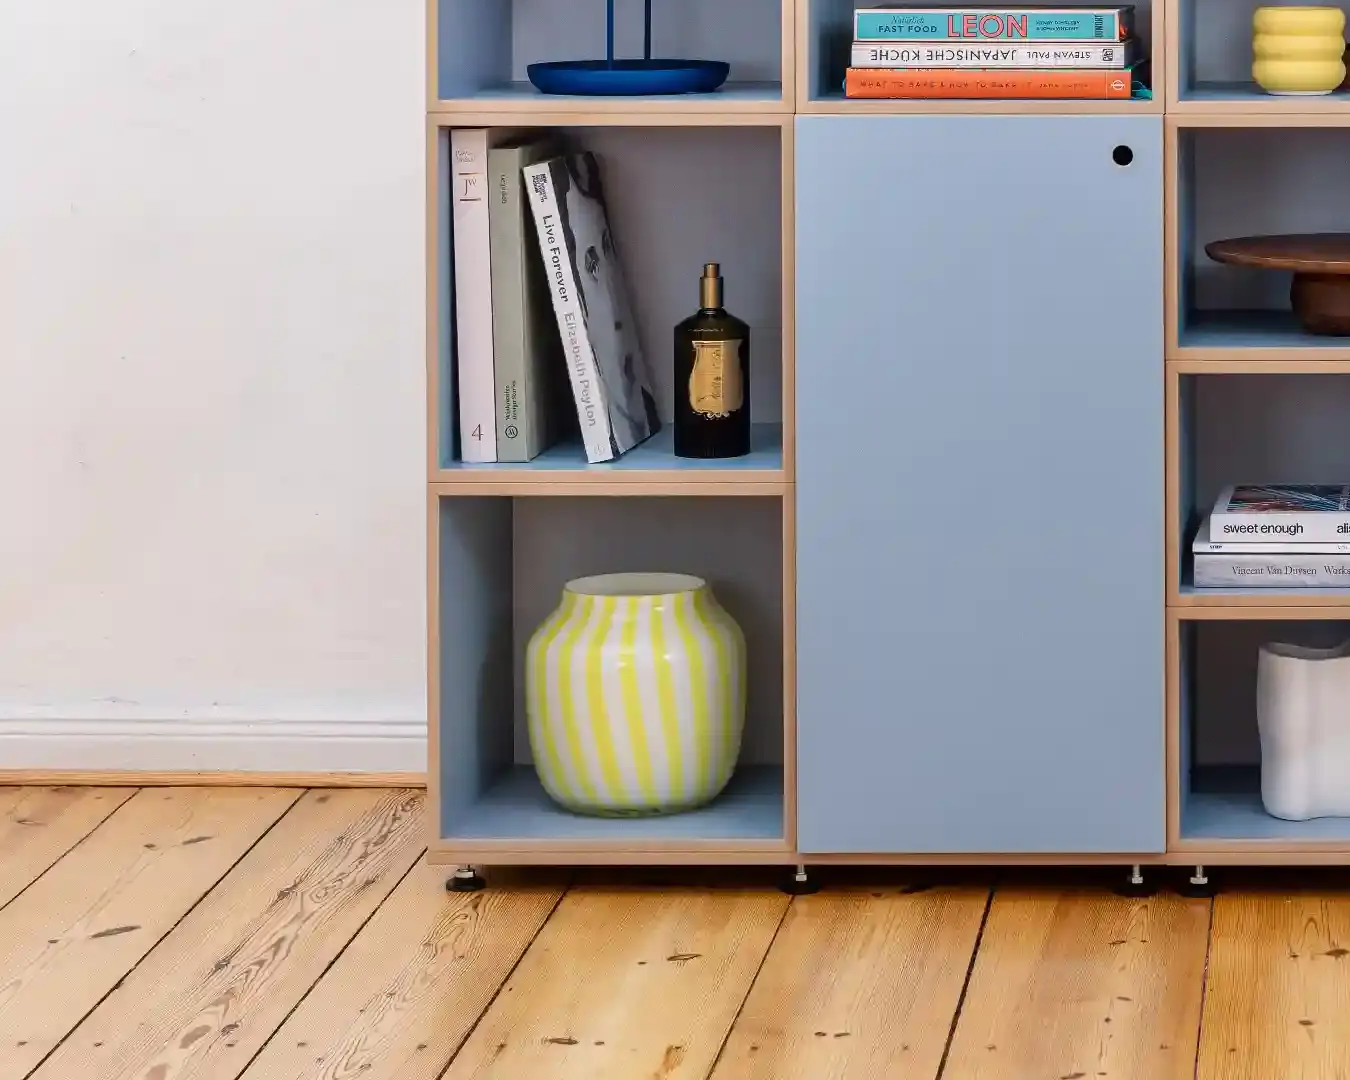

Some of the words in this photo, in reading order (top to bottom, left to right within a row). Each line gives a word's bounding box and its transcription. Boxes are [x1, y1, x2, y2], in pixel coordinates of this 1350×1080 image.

[878, 25, 904, 33] FAST
[908, 25, 938, 33] FOOD
[947, 15, 1028, 38] LEON
[870, 49, 920, 62] KÜCHE
[926, 49, 1017, 61] JAPANISCHE
[1027, 51, 1050, 59] PAUL
[1053, 51, 1091, 59] STEVAN
[542, 214, 556, 245] Live
[552, 247, 569, 303] Forever
[564, 312, 587, 377] Elizabeth
[579, 379, 597, 428] Peyton
[471, 423, 484, 441] 4
[1223, 524, 1258, 534] sweet
[1260, 523, 1304, 536] enough
[1231, 566, 1264, 575] Vincent
[1266, 566, 1282, 575] Van
[1284, 566, 1317, 577] Duysen
